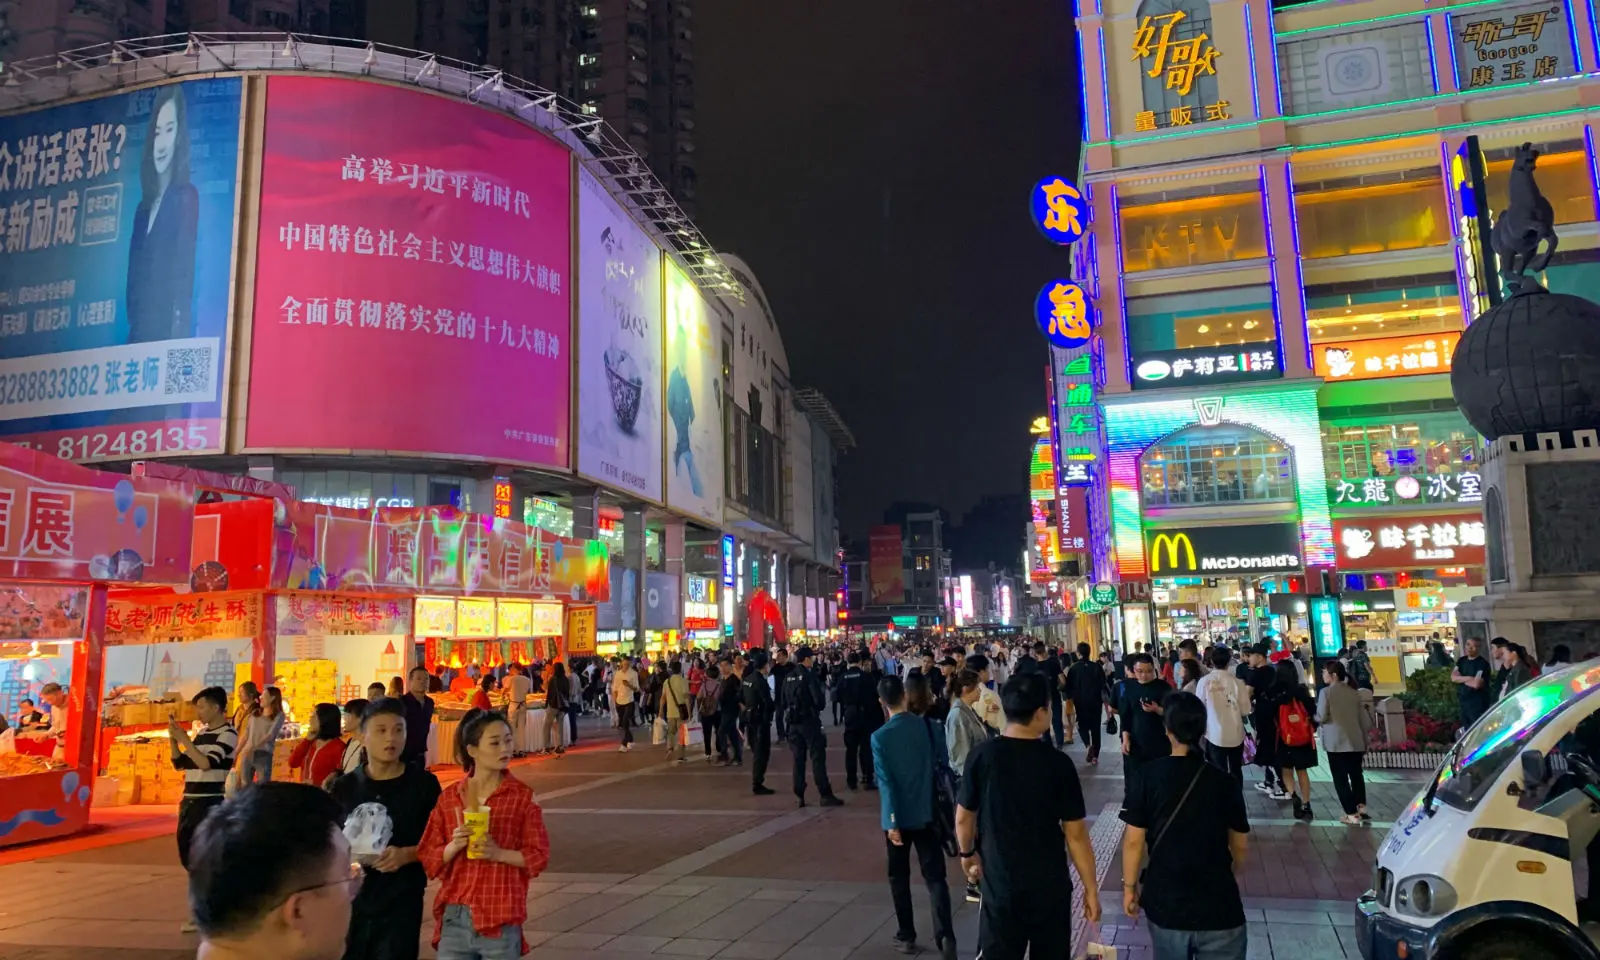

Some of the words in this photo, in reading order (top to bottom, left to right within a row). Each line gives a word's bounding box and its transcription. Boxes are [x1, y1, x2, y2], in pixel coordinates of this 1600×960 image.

[1131, 10, 1222, 96] 好歌
[1470, 55, 1558, 88] 康王店
[1135, 100, 1229, 132] 量贩式
[341, 154, 531, 219] 高举习近平新时代
[0, 191, 79, 253] 新励成
[279, 221, 561, 296] 中国特色社会主义思想伟大旗帜
[1144, 214, 1239, 268] KTV
[279, 295, 560, 360] 全面贯彻落实党的十九大精神
[104, 357, 160, 396] 张老师
[1172, 355, 1239, 378] 萨莉亚
[57, 426, 208, 461] 81248135
[1336, 477, 1390, 503] 九龍
[1426, 472, 1483, 503] 冰室
[1202, 555, 1298, 570] McDonald's
[105, 599, 248, 631] 赵老师花生酥
[287, 596, 401, 620] 赵老师花生酥
